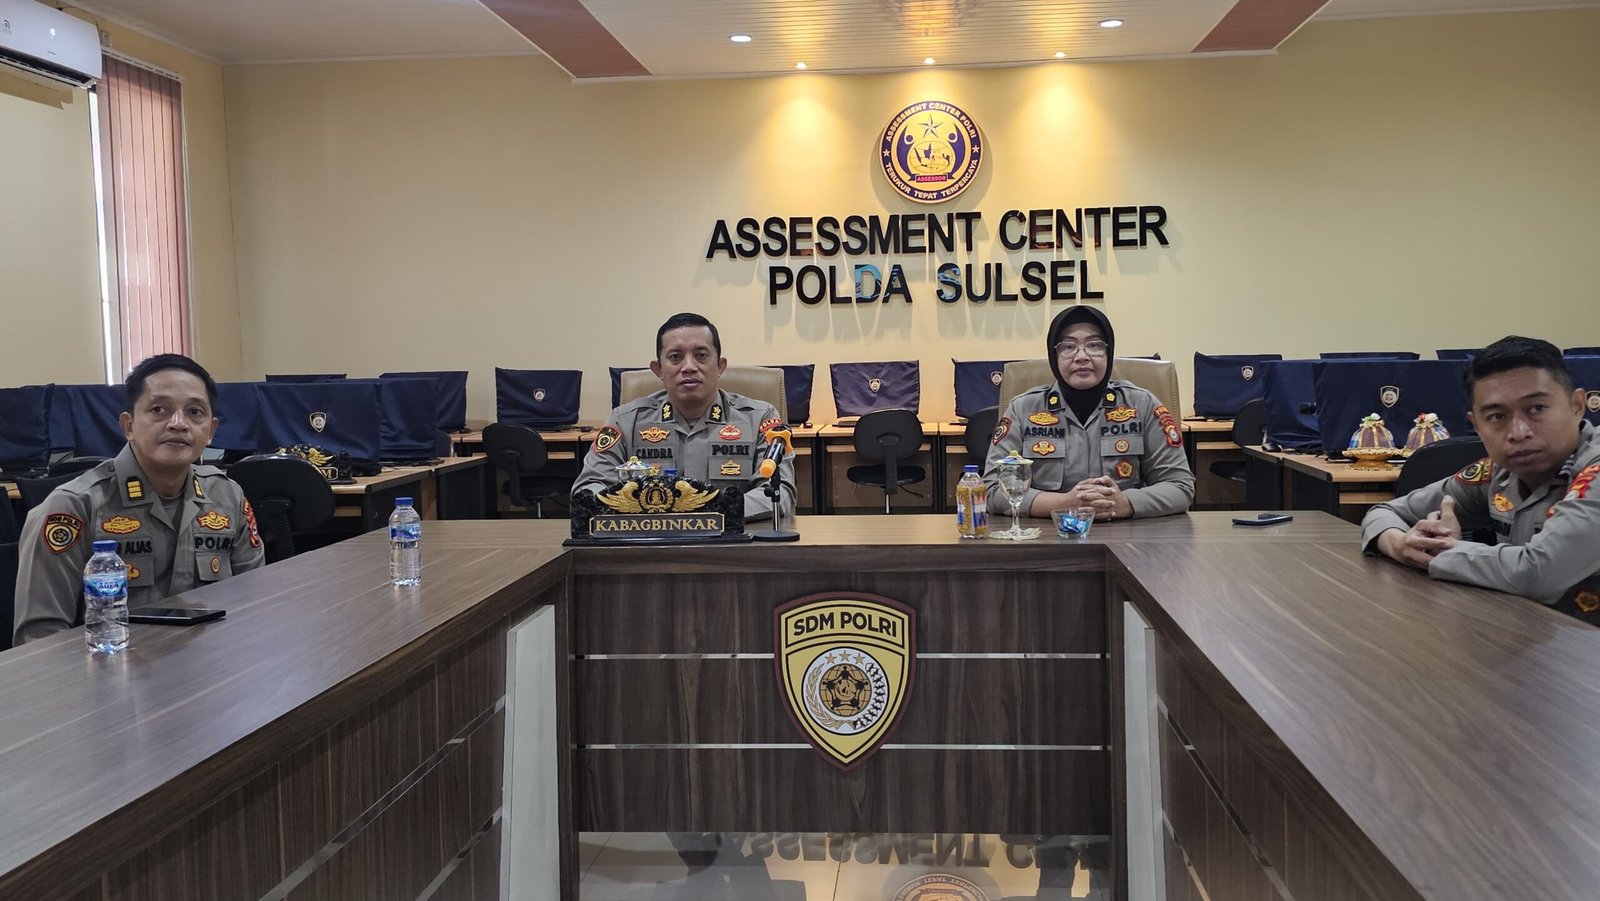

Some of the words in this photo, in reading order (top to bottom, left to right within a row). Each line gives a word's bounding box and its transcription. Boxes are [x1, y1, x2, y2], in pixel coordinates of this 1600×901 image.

[885, 102, 928, 142] ASSESSMENT
[928, 101, 961, 119] CENTER
[959, 115, 977, 139] POLRI
[885, 162, 912, 195] TERUKUR
[914, 190, 938, 200] TEPAT
[940, 159, 979, 198] TERPERCAYA
[916, 175, 947, 183] ASSESSOR
[705, 211, 982, 259] ASSESSMENT
[999, 205, 1169, 250] CENTER
[769, 263, 913, 305] POLDA
[936, 259, 1104, 303] SULSEL
[1100, 420, 1142, 436] POLRI
[711, 444, 750, 456] POLRI
[595, 518, 720, 532] KABAGBINKAR
[793, 612, 835, 637] SDM
[840, 611, 897, 638] POLRI
